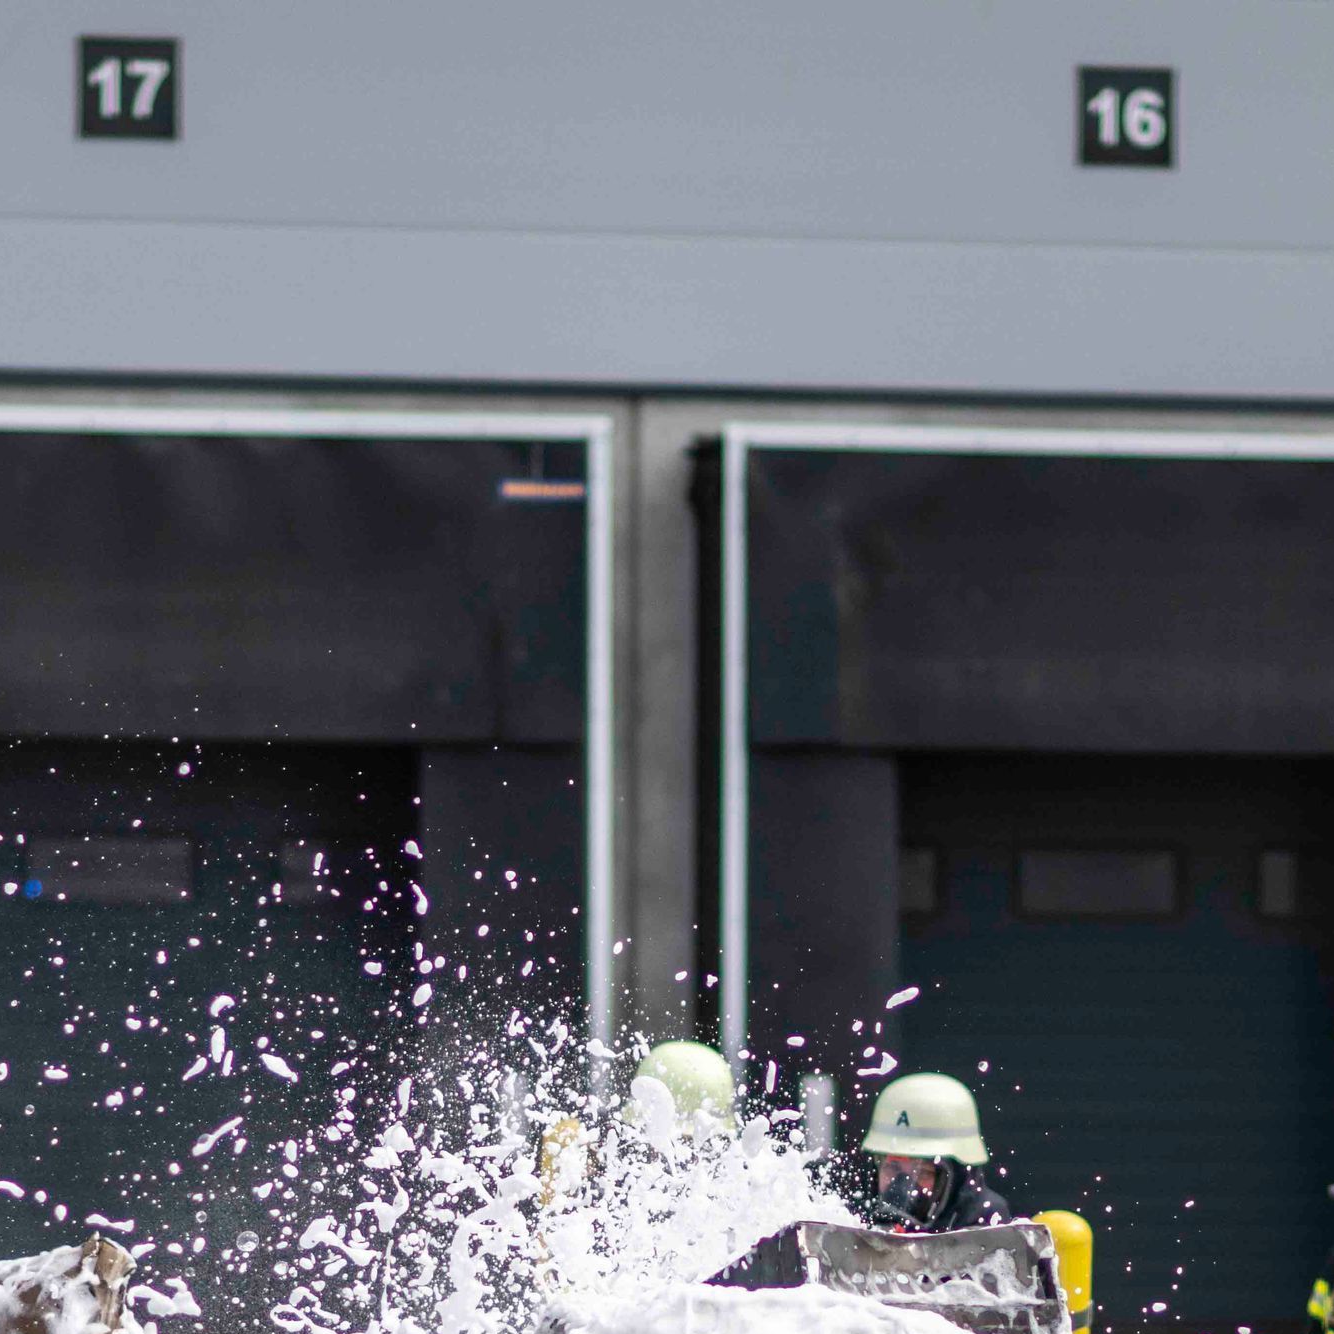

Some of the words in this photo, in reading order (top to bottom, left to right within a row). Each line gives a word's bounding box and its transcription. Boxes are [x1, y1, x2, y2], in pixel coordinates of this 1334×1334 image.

[87, 58, 170, 120] 17
[1087, 88, 1167, 148] 16
[896, 1110, 910, 1127] A
